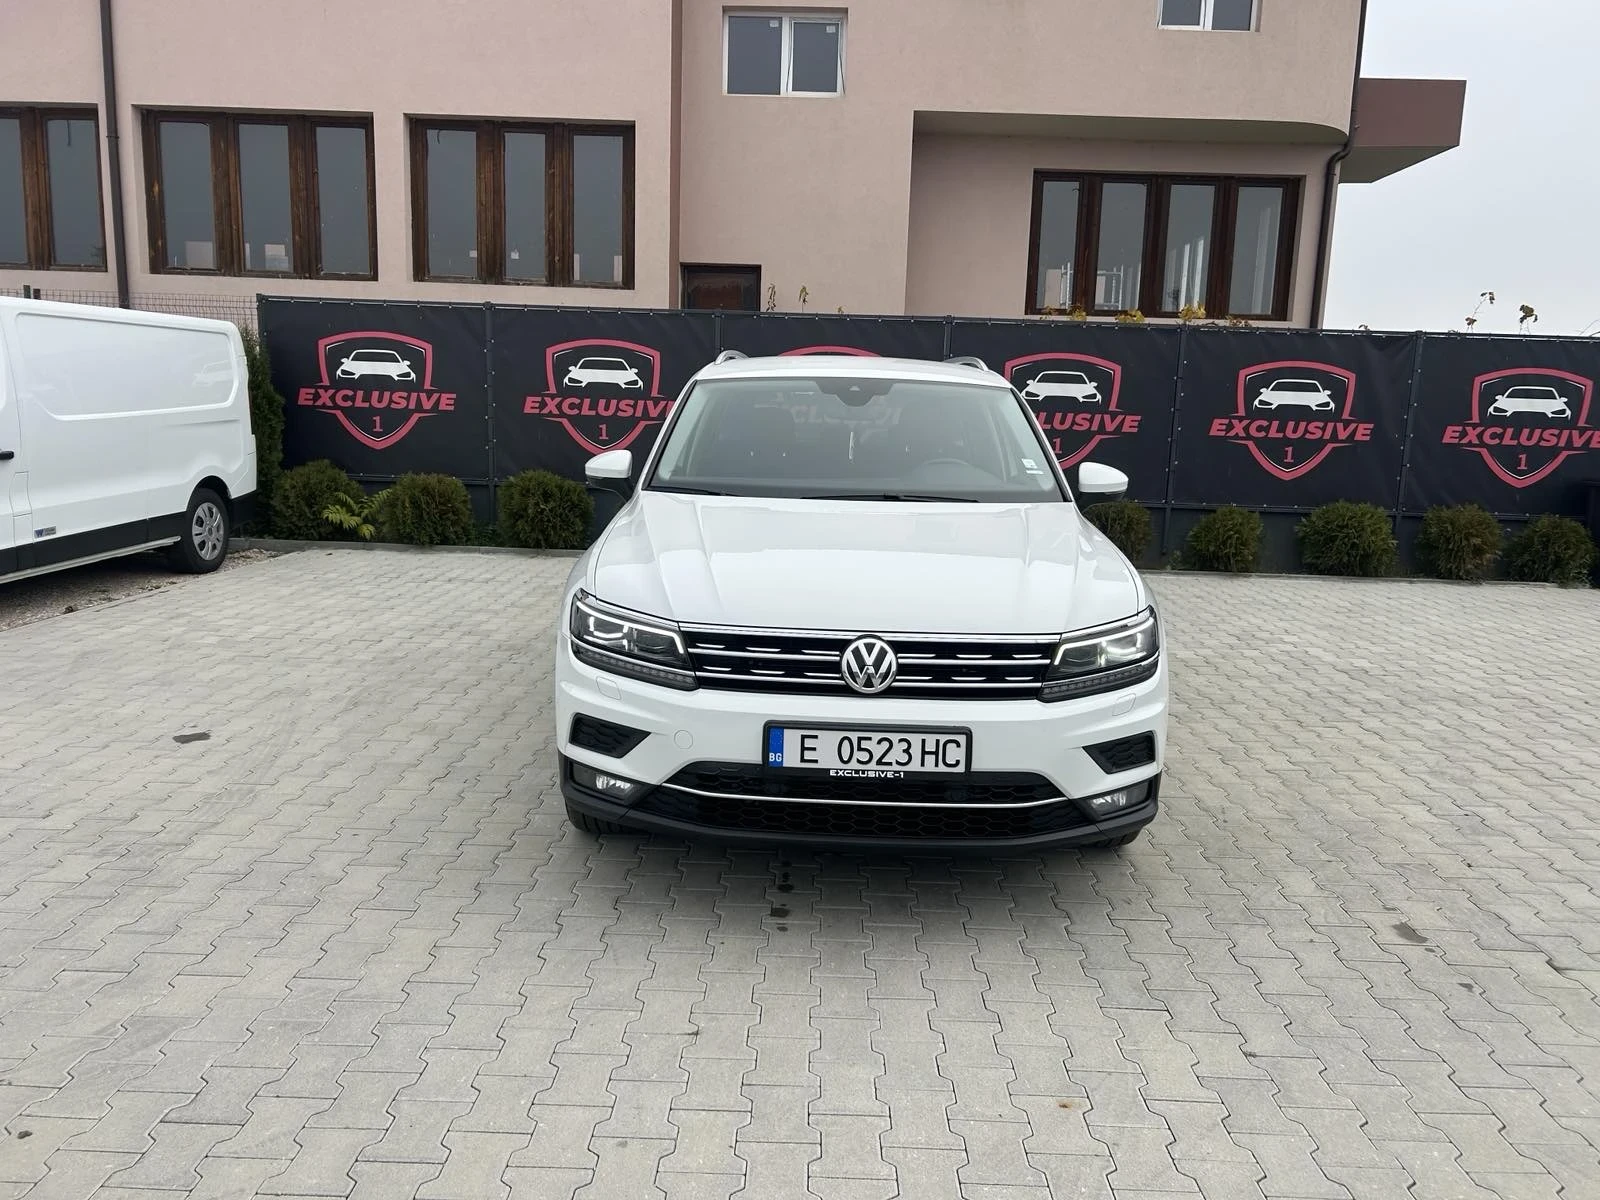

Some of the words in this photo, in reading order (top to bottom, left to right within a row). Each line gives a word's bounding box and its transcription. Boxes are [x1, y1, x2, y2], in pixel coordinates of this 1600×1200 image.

[298, 387, 456, 412] EXCLUSIVE
[372, 415, 383, 433] 1
[1035, 411, 1141, 433] LUSIVE
[1209, 418, 1375, 442] EXCLUSIVE
[598, 423, 609, 440] 1
[1052, 438, 1063, 454] 1
[1284, 446, 1295, 463] 1
[1516, 454, 1528, 470] 1
[769, 752, 782, 762] BG
[800, 734, 818, 764] E
[837, 736, 913, 767] 0523
[920, 738, 961, 768] HC
[829, 769, 904, 778] EXCLUSIVE-1
